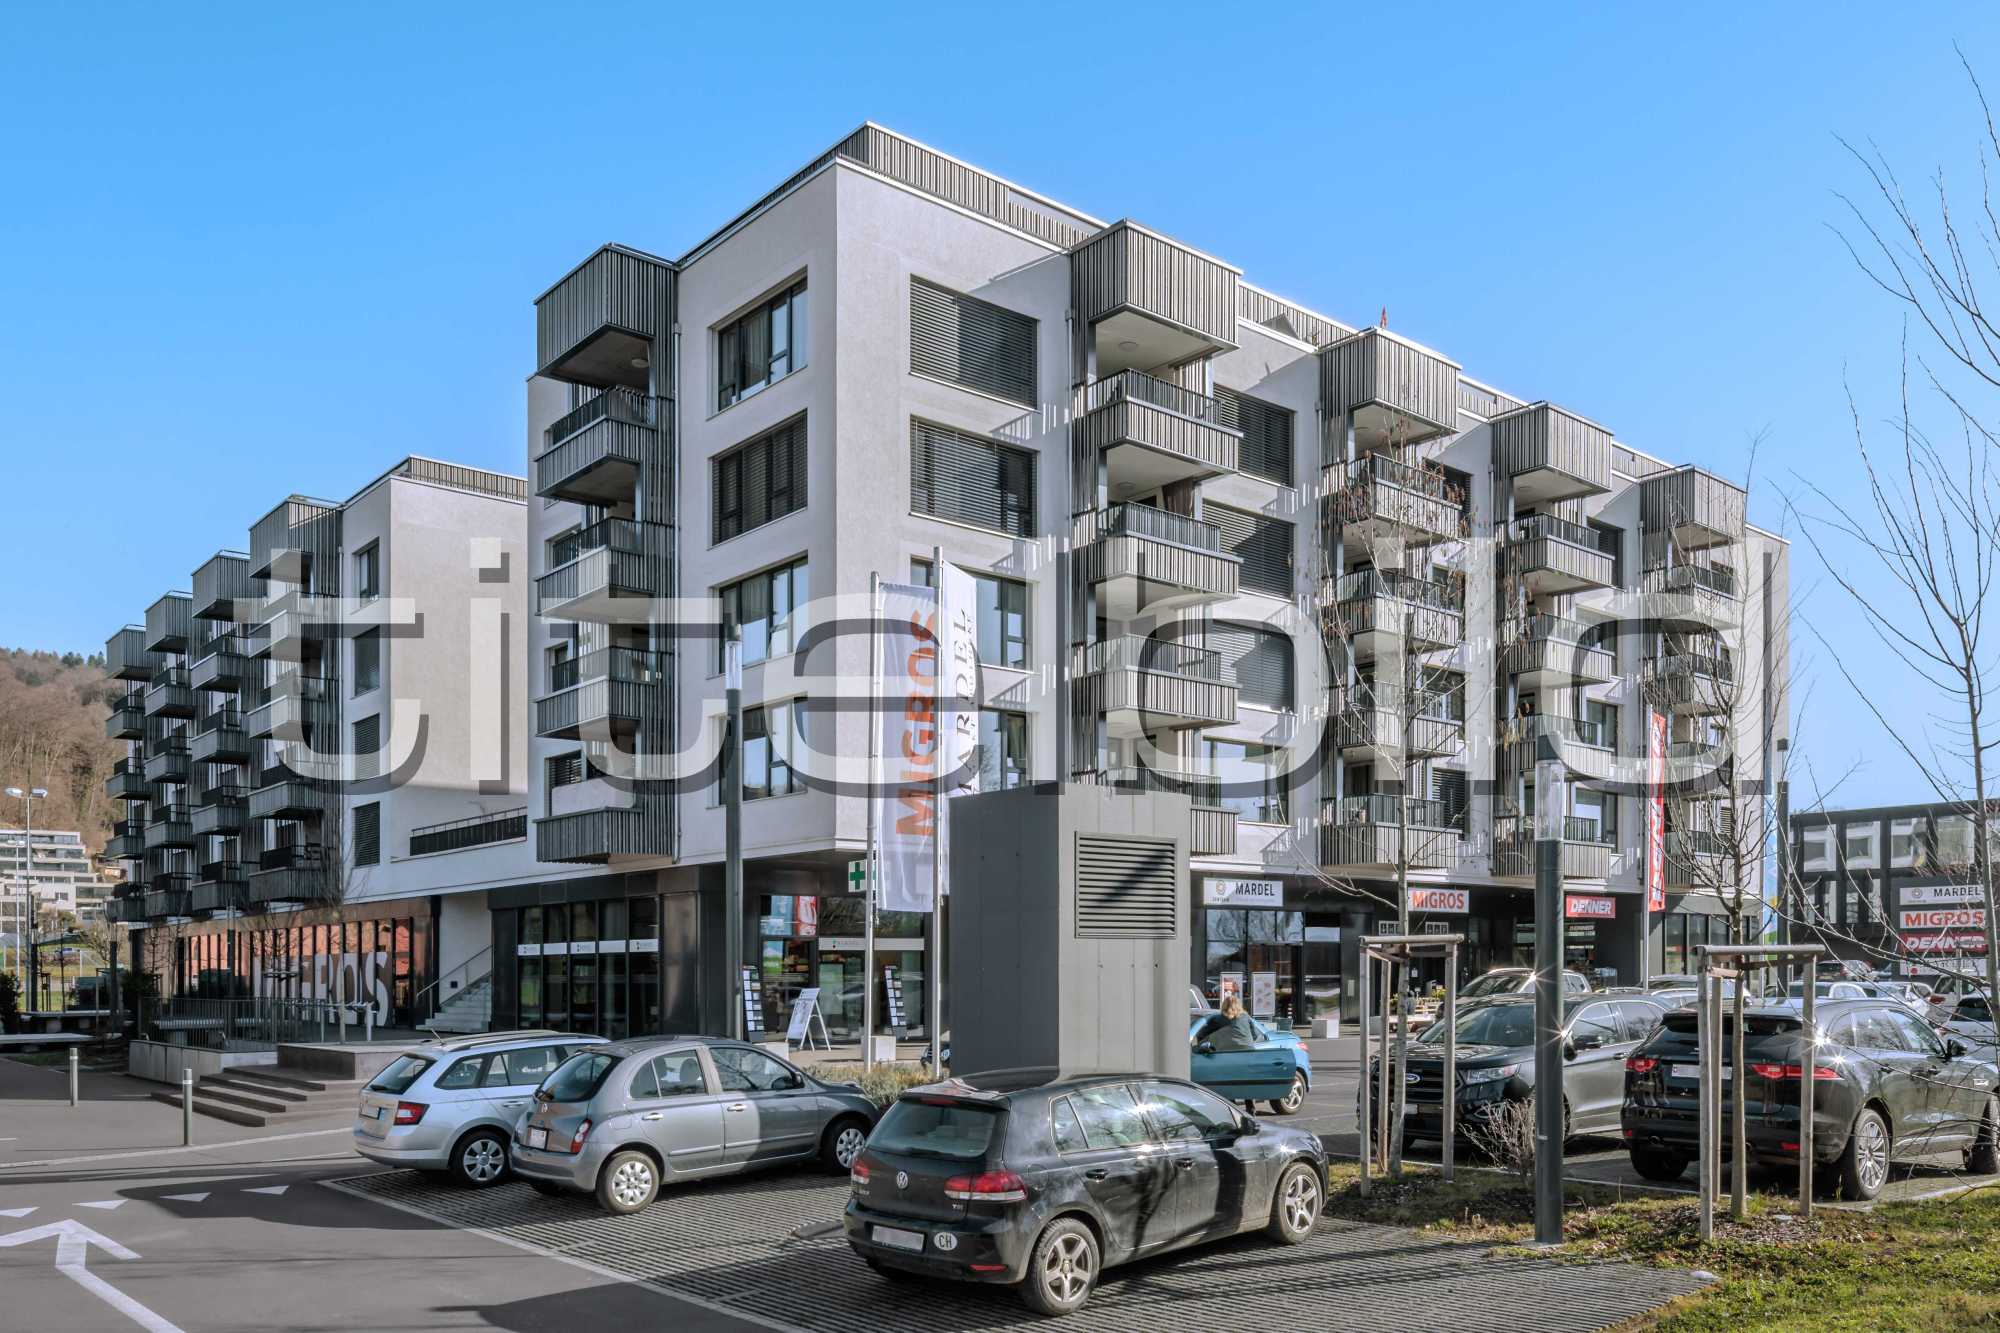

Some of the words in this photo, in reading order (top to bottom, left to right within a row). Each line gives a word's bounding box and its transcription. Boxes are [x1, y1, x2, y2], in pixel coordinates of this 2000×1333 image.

[896, 608, 937, 836] MIGROS
[1235, 882, 1275, 896] MARDEL
[1933, 886, 1981, 897] MARDEL
[1413, 892, 1465, 909] MIGROS
[1570, 898, 1612, 914] DENNER
[1904, 911, 1984, 927] MIGROS
[938, 1234, 953, 1249] CH
